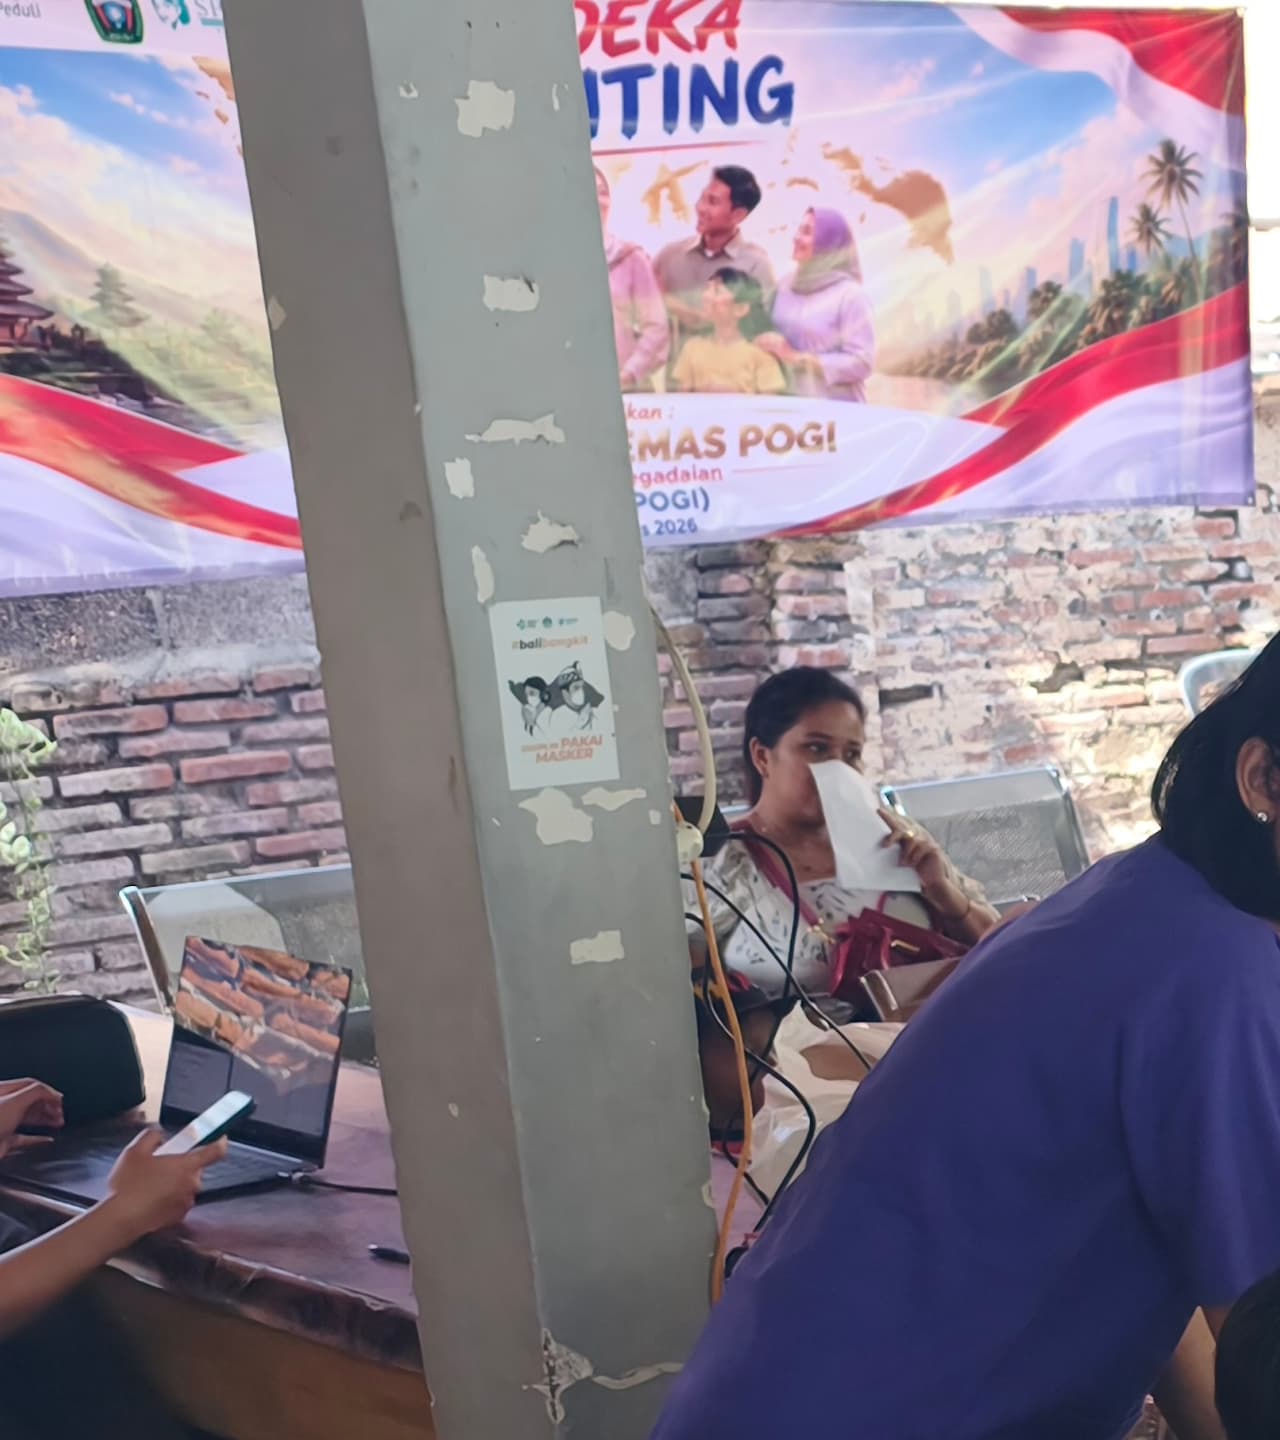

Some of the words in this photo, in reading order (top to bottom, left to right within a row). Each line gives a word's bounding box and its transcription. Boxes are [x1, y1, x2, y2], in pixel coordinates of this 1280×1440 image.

[0, 3, 41, 18] eduli
[629, 425, 728, 462] MAS
[739, 421, 838, 457] POGI
[634, 464, 724, 489] gadaian
[654, 517, 699, 536] 2026
